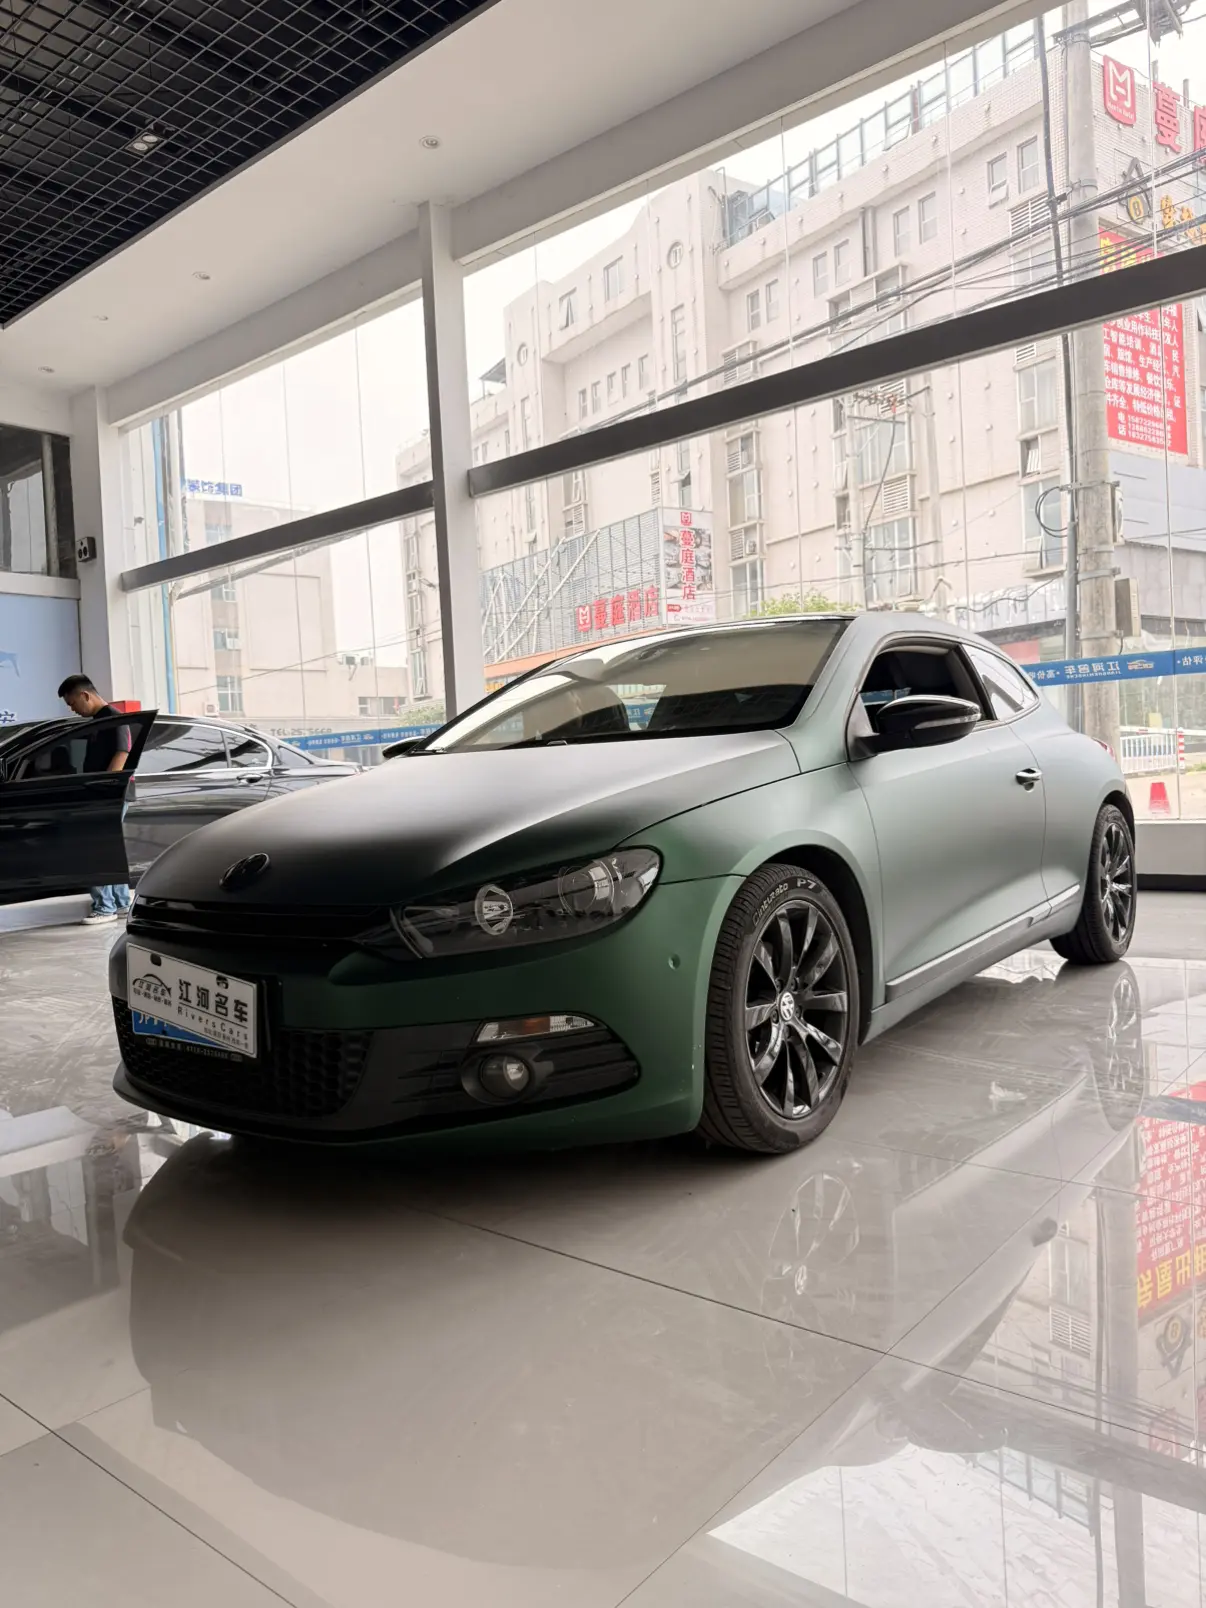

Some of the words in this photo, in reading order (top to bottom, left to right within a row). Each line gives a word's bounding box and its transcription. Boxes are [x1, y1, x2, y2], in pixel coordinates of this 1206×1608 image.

[680, 530, 696, 600] 蔓庭酒店
[797, 878, 817, 889] P7
[178, 978, 248, 1024] 江河名车
